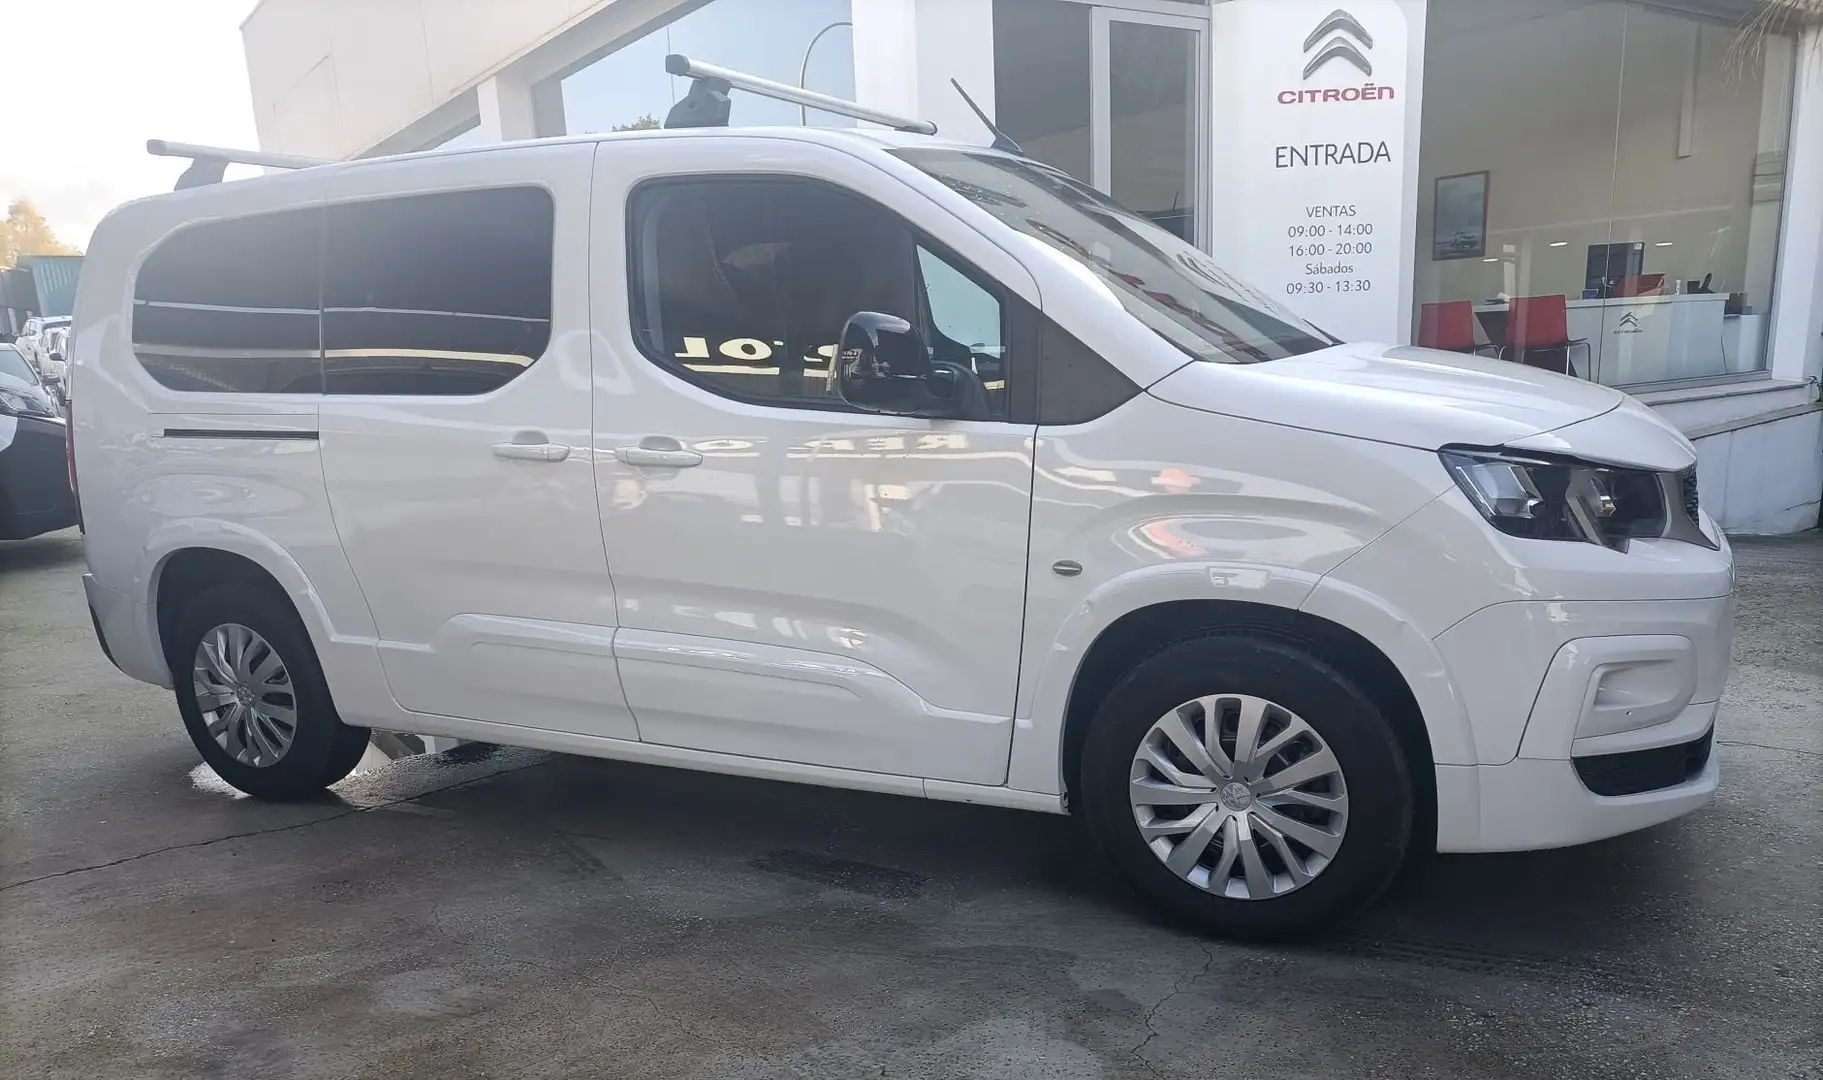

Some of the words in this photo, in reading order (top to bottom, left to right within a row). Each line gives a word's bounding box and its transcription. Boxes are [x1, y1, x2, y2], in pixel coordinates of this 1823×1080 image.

[1275, 141, 1391, 168] ENTRADA
[1306, 205, 1356, 218] VENTAS
[1288, 225, 1326, 238] 09:00
[1336, 223, 1373, 236] 14:00
[1289, 244, 1327, 257] 16:00
[1335, 243, 1372, 255] 20:00
[1305, 262, 1354, 276] Sábados
[1286, 282, 1324, 295] 09:30
[1335, 280, 1371, 293] 13:30
